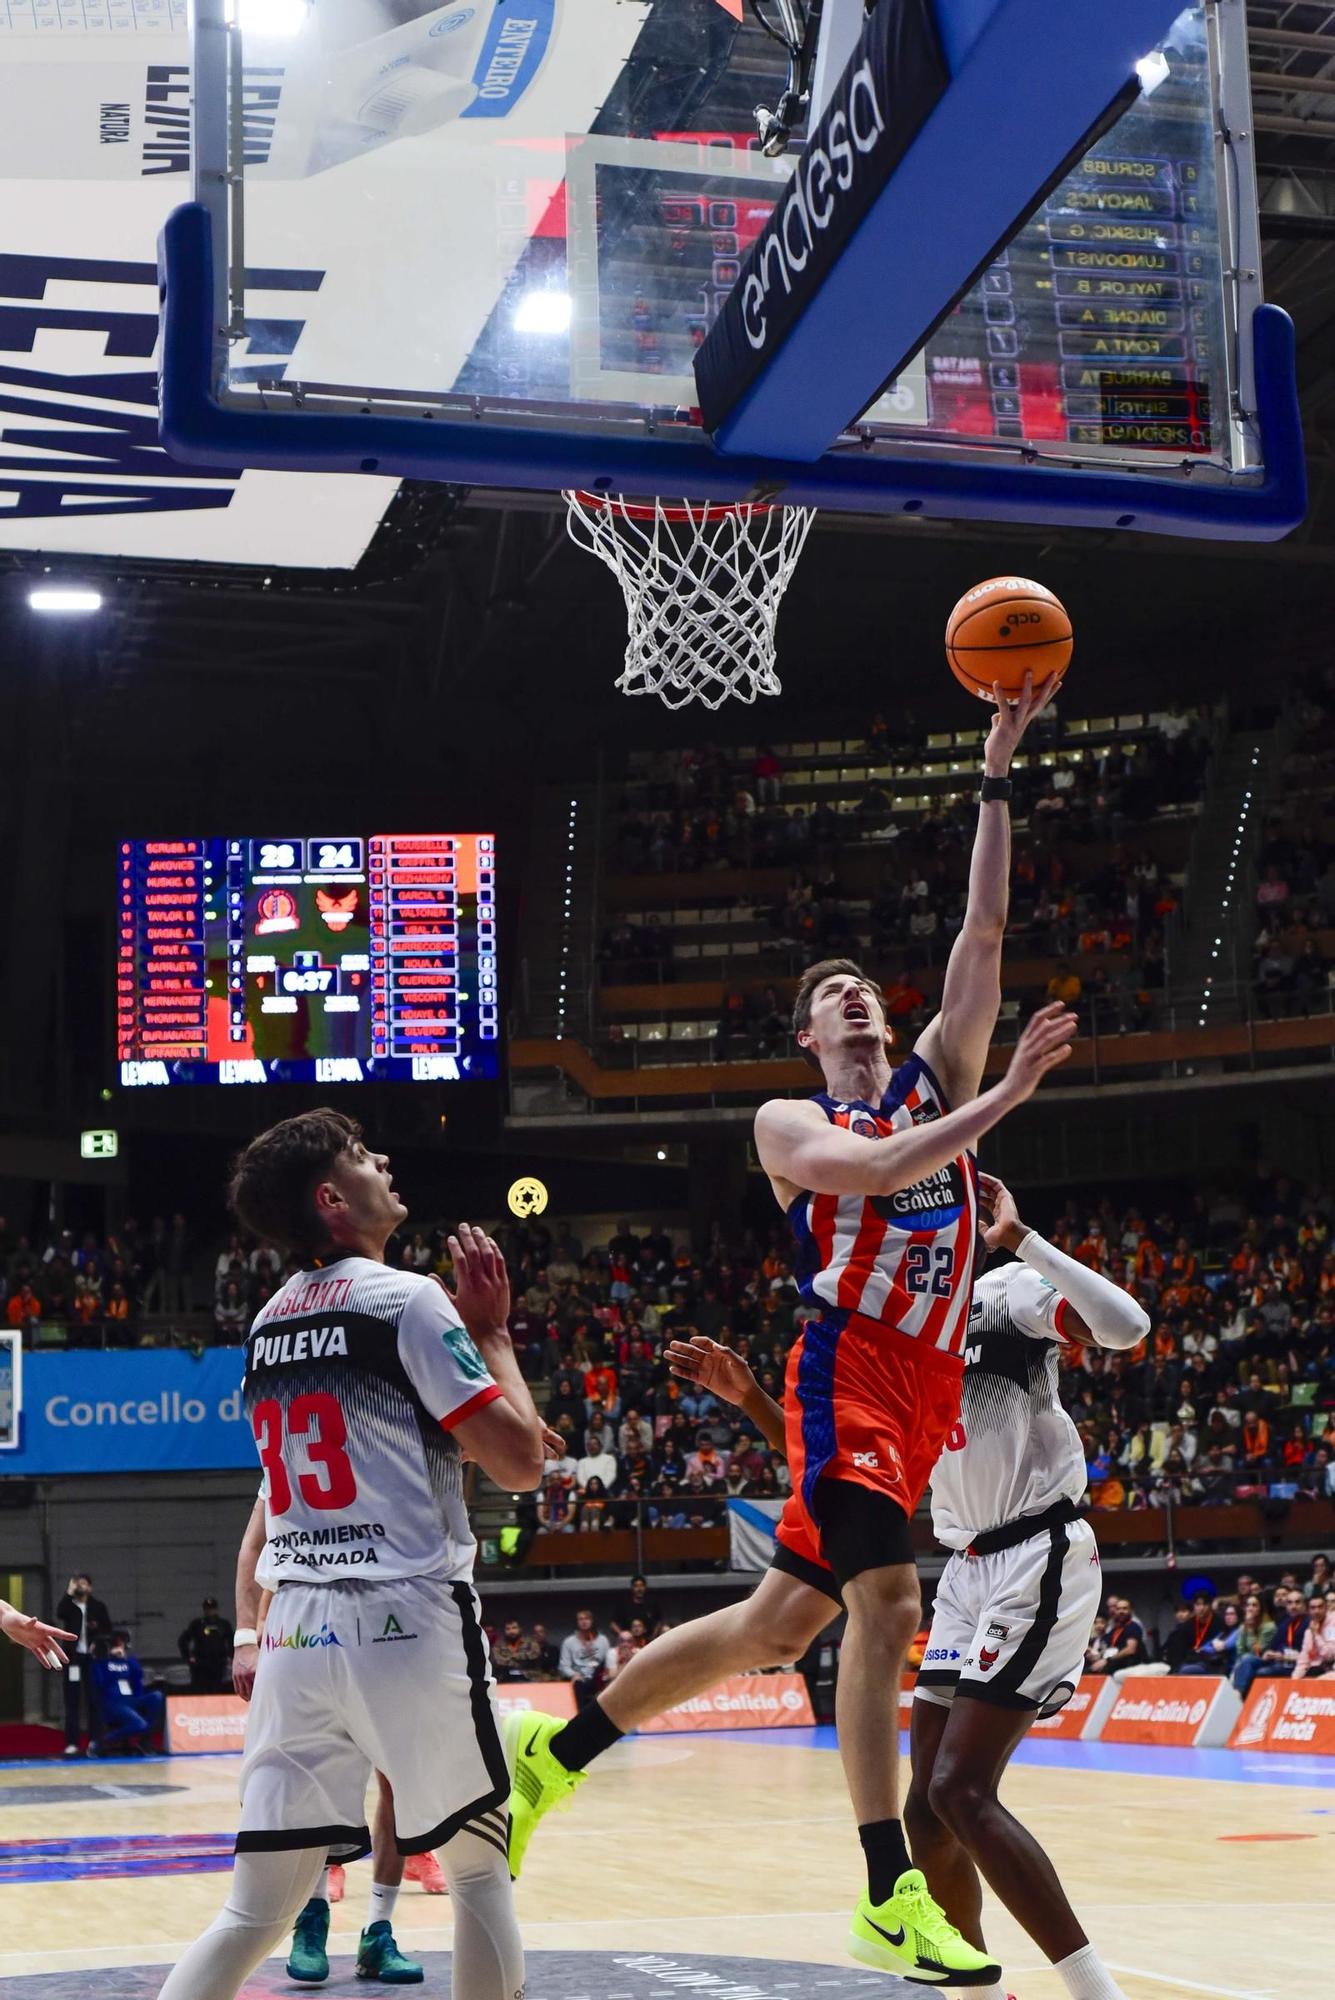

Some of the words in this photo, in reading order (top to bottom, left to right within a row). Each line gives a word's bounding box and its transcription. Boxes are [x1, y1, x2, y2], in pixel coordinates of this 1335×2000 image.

[479, 18, 538, 99] ENTEIRO
[100, 103, 131, 144] NATURA
[741, 58, 885, 349] endesa
[1006, 612, 1041, 627] acb
[260, 844, 295, 868] 28
[319, 844, 354, 868] 24
[283, 971, 333, 992] 6:37
[893, 1185, 955, 1213] Galicia
[906, 1244, 955, 1299] 22
[252, 1326, 348, 1371] PULEVA
[45, 1390, 206, 1427] Concello
[253, 1391, 357, 1517] 33
[714, 1694, 778, 1711] Galicia
